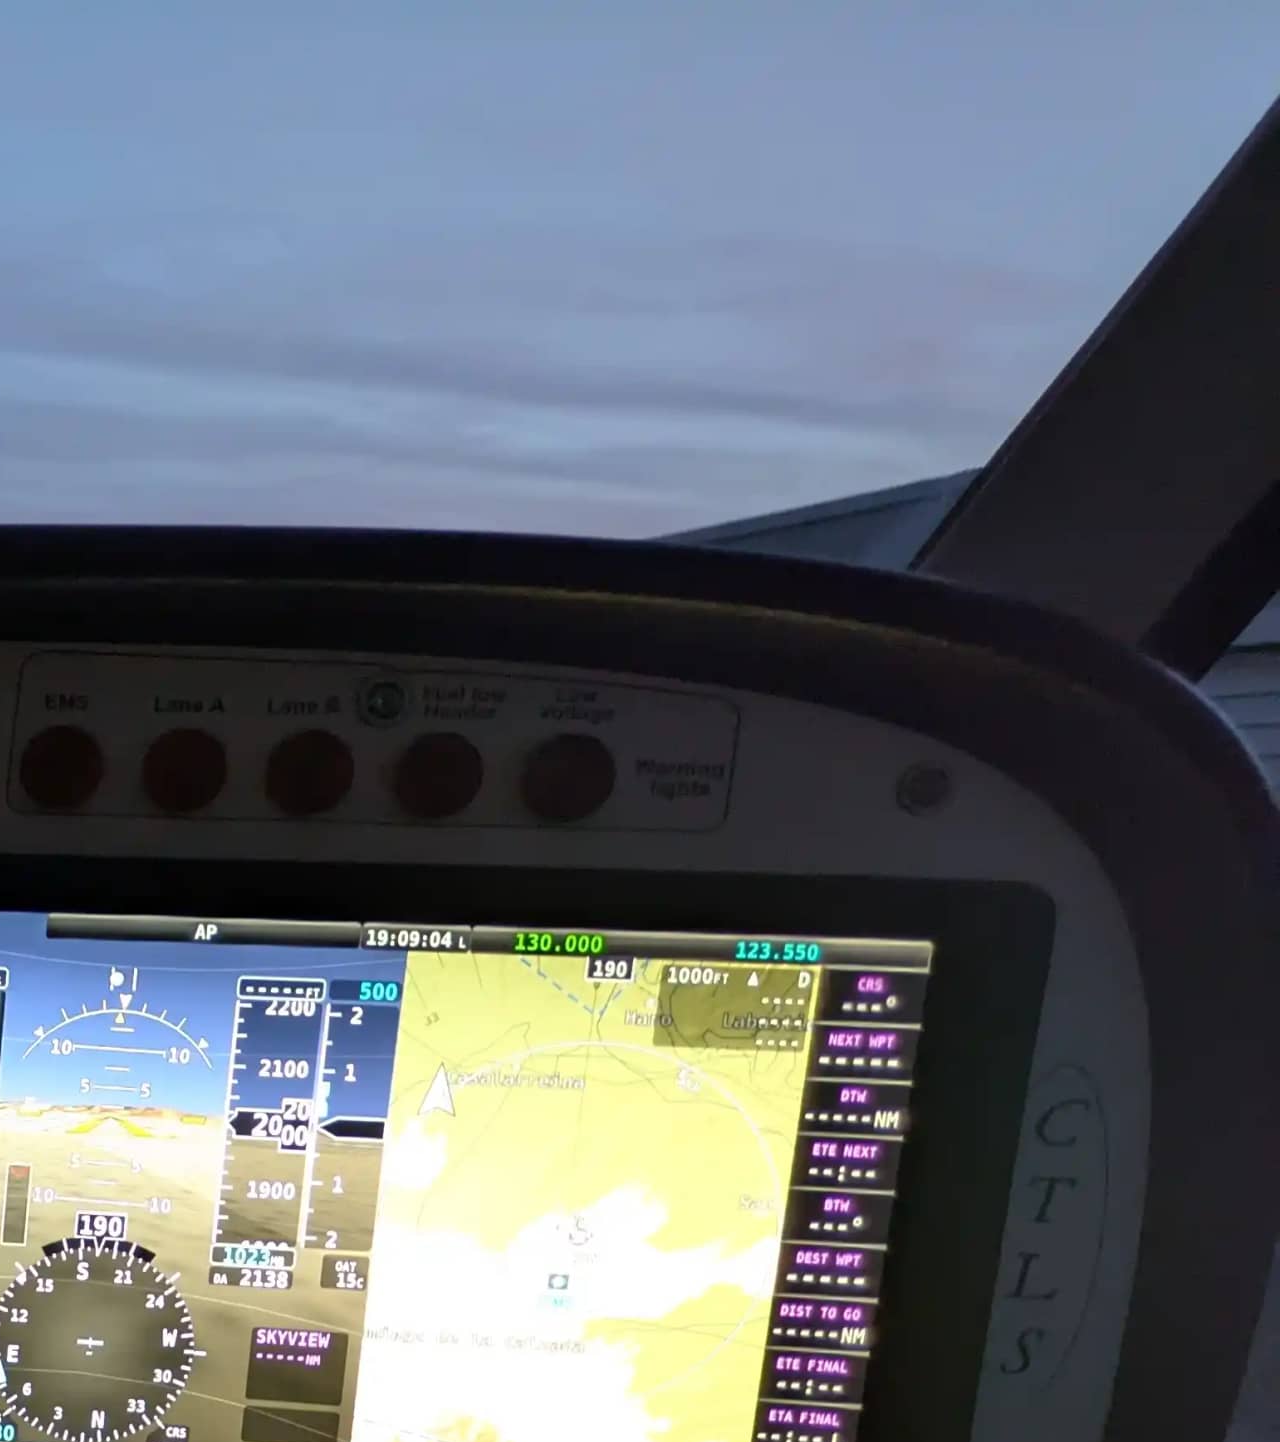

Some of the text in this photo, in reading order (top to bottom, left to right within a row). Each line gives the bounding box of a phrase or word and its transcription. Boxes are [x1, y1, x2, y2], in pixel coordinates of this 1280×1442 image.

[154, 696, 225, 713] Lane A
[195, 924, 218, 940] AP
[366, 929, 452, 947] 19:09:04
[514, 934, 603, 952] 130.000
[735, 942, 820, 961] 123.550
[594, 960, 627, 977] 190
[359, 984, 398, 1000] 500
[828, 1034, 896, 1048] NEXT WPT
[258, 1061, 309, 1078] 2100
[813, 1144, 878, 1158] ETE NEXT
[247, 1182, 295, 1199] 1900
[79, 1216, 121, 1236] 190
[796, 1253, 861, 1267] DEST WPT
[240, 1270, 288, 1288] 2138
[780, 1306, 860, 1320] DIST TO GO
[256, 1330, 330, 1348] SKYVIEW
[841, 1328, 866, 1344] NM
[777, 1359, 847, 1373] ETE FINAL
[769, 1411, 839, 1425] ETA FINAL
